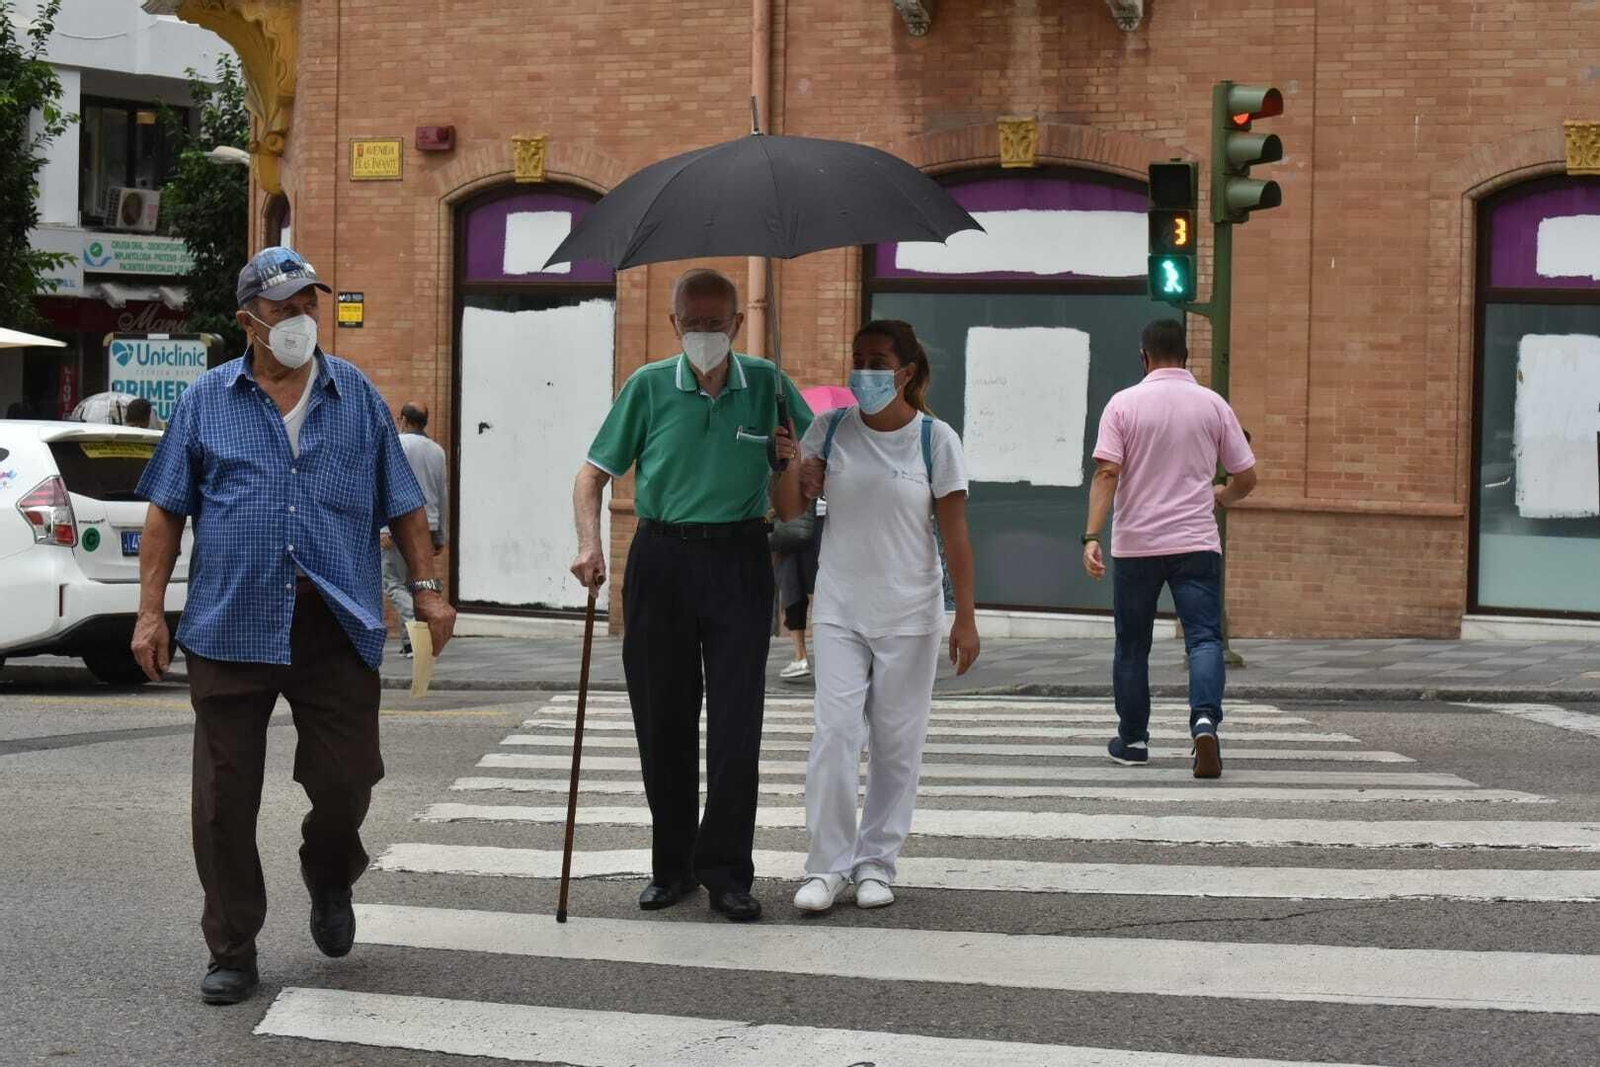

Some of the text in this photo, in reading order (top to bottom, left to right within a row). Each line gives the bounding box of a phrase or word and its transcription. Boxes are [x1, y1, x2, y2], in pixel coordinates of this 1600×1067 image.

[1174, 218, 1187, 246] 3
[137, 343, 205, 367] Uniclinic
[112, 379, 189, 400] PRIMER
